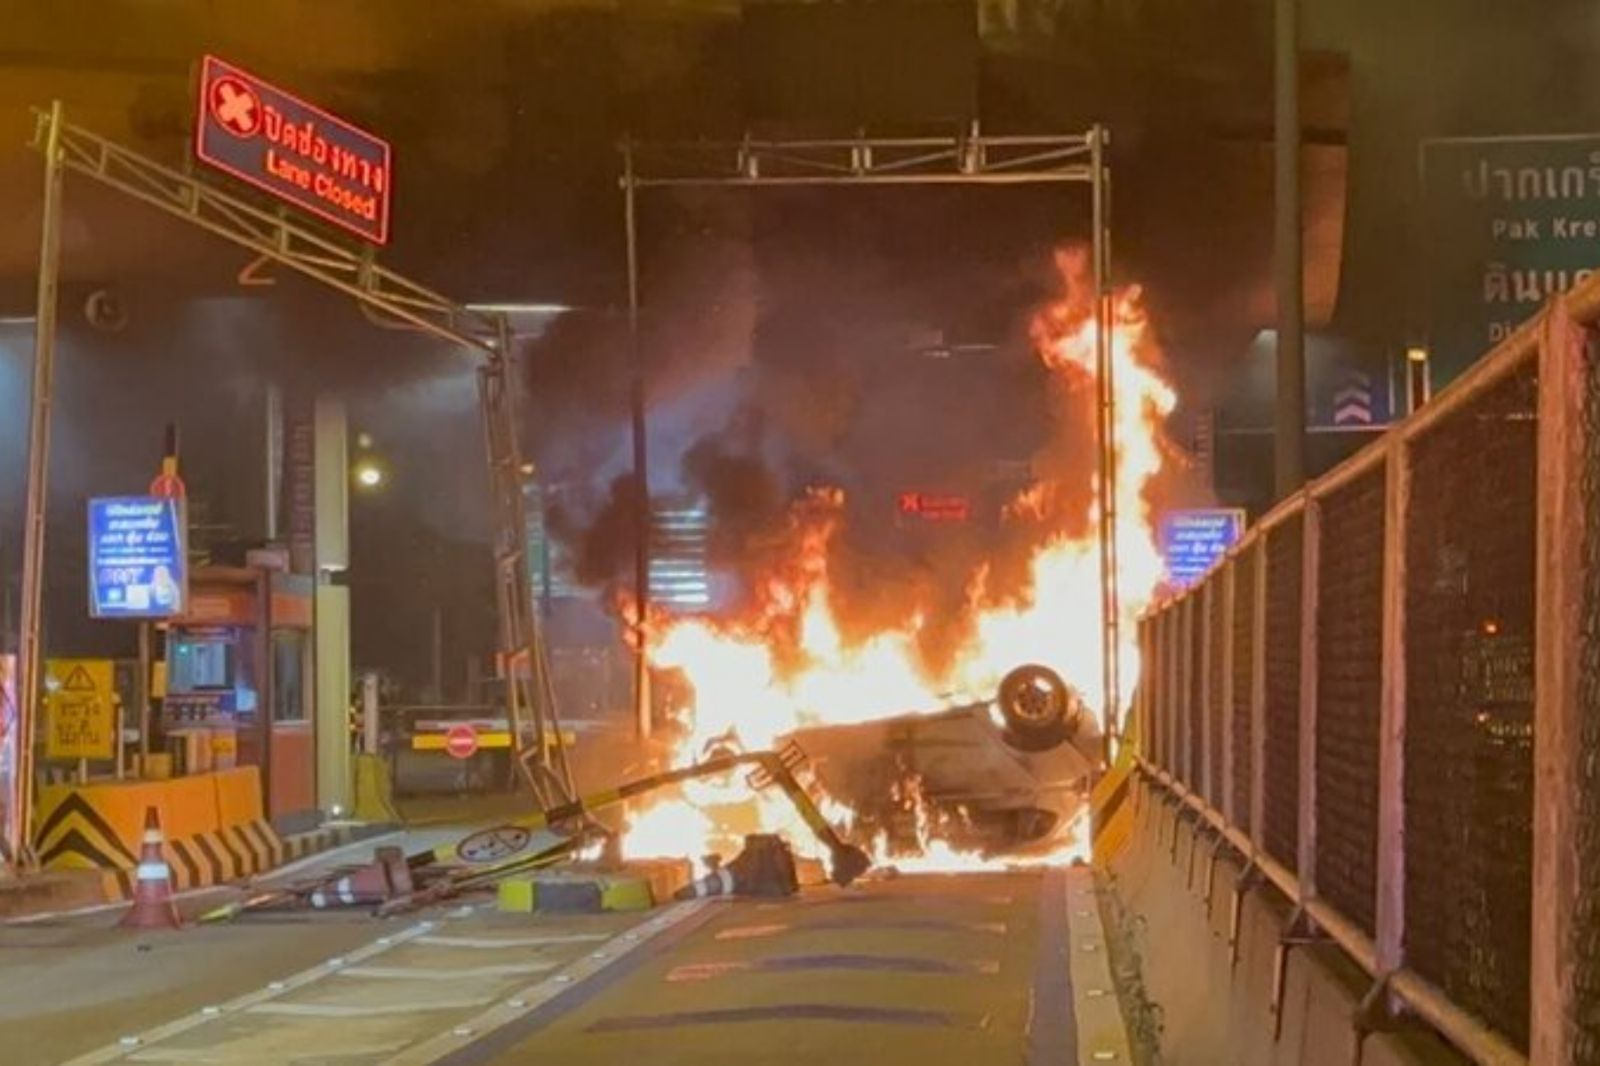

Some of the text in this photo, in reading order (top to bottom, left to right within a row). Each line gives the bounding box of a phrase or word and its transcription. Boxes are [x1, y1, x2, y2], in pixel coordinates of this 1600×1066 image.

[263, 104, 383, 193] ปิดช่องทาง
[266, 149, 377, 221] Lane Closed
[1493, 216, 1600, 240] Pak Kre
